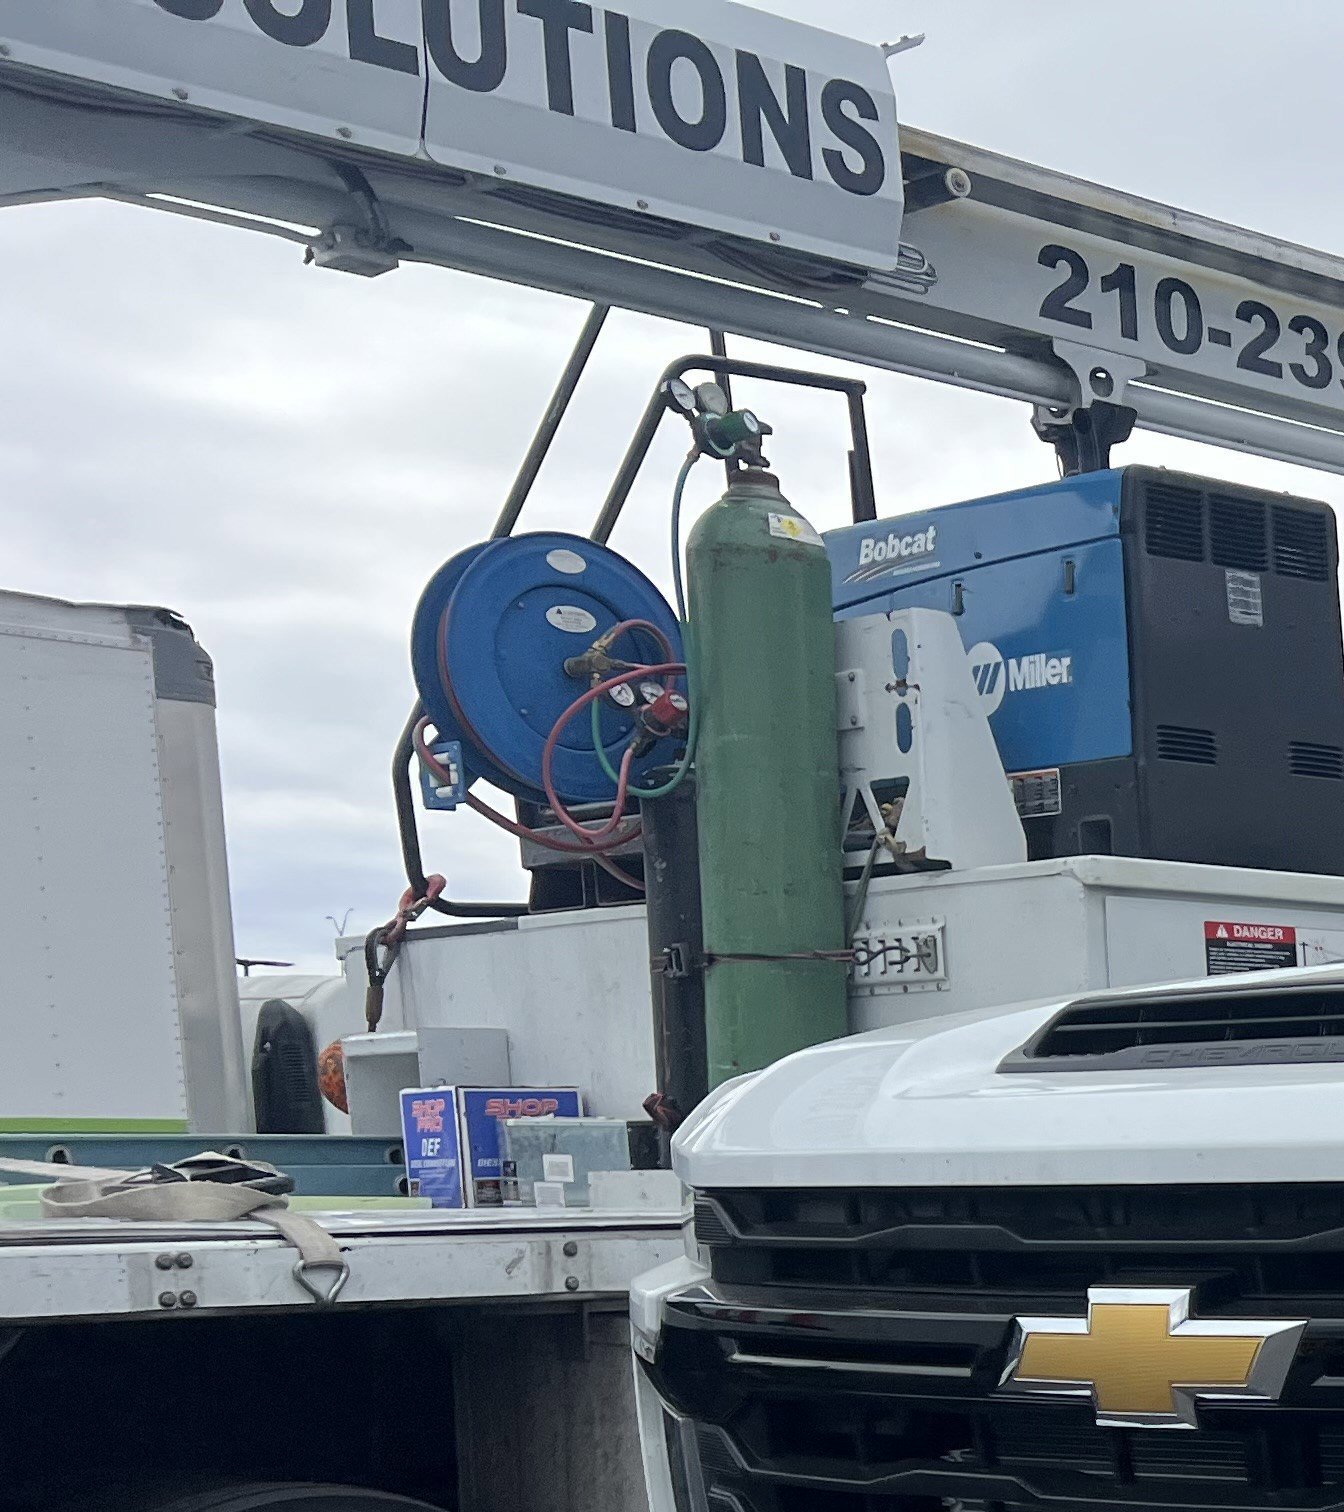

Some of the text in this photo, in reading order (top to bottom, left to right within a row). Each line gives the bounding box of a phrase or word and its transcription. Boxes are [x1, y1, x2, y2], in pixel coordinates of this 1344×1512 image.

[154, 0, 884, 195] LUTIONS
[859, 525, 936, 565] Bobcat
[1008, 653, 1072, 692] Miller
[1233, 924, 1283, 940] DANGER
[485, 1099, 558, 1116] SHOP
[421, 1138, 440, 1157] DEF
